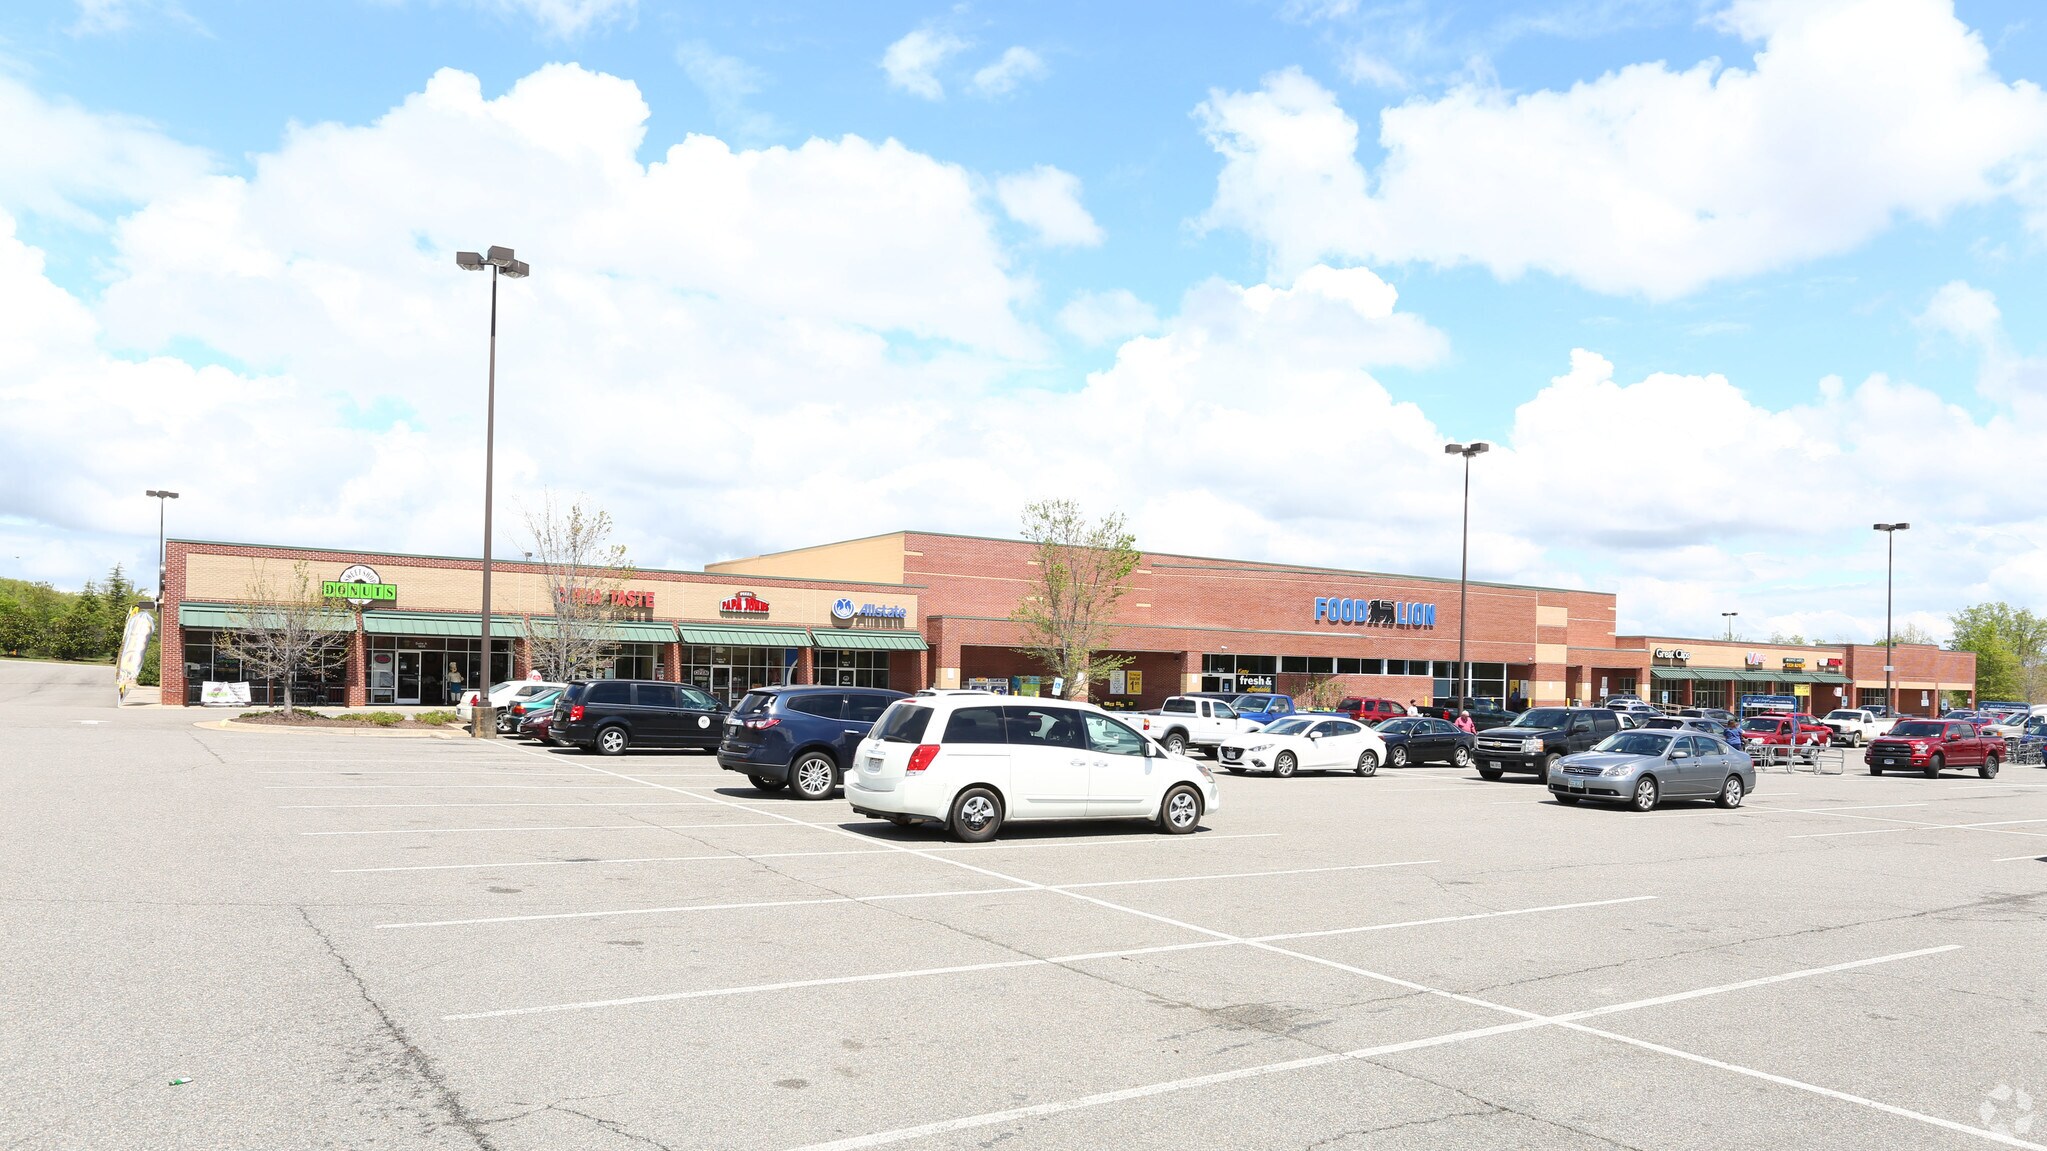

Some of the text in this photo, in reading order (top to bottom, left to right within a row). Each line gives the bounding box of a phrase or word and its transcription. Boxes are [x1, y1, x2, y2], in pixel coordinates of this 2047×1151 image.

[325, 584, 394, 597] DONUTS
[609, 590, 656, 608] TASTE
[722, 597, 743, 611] PAPA
[857, 603, 907, 618] Allstate
[1314, 596, 1437, 626] FOOD LION
[1656, 647, 1675, 659] Great
[1239, 675, 1273, 686] fresh &
